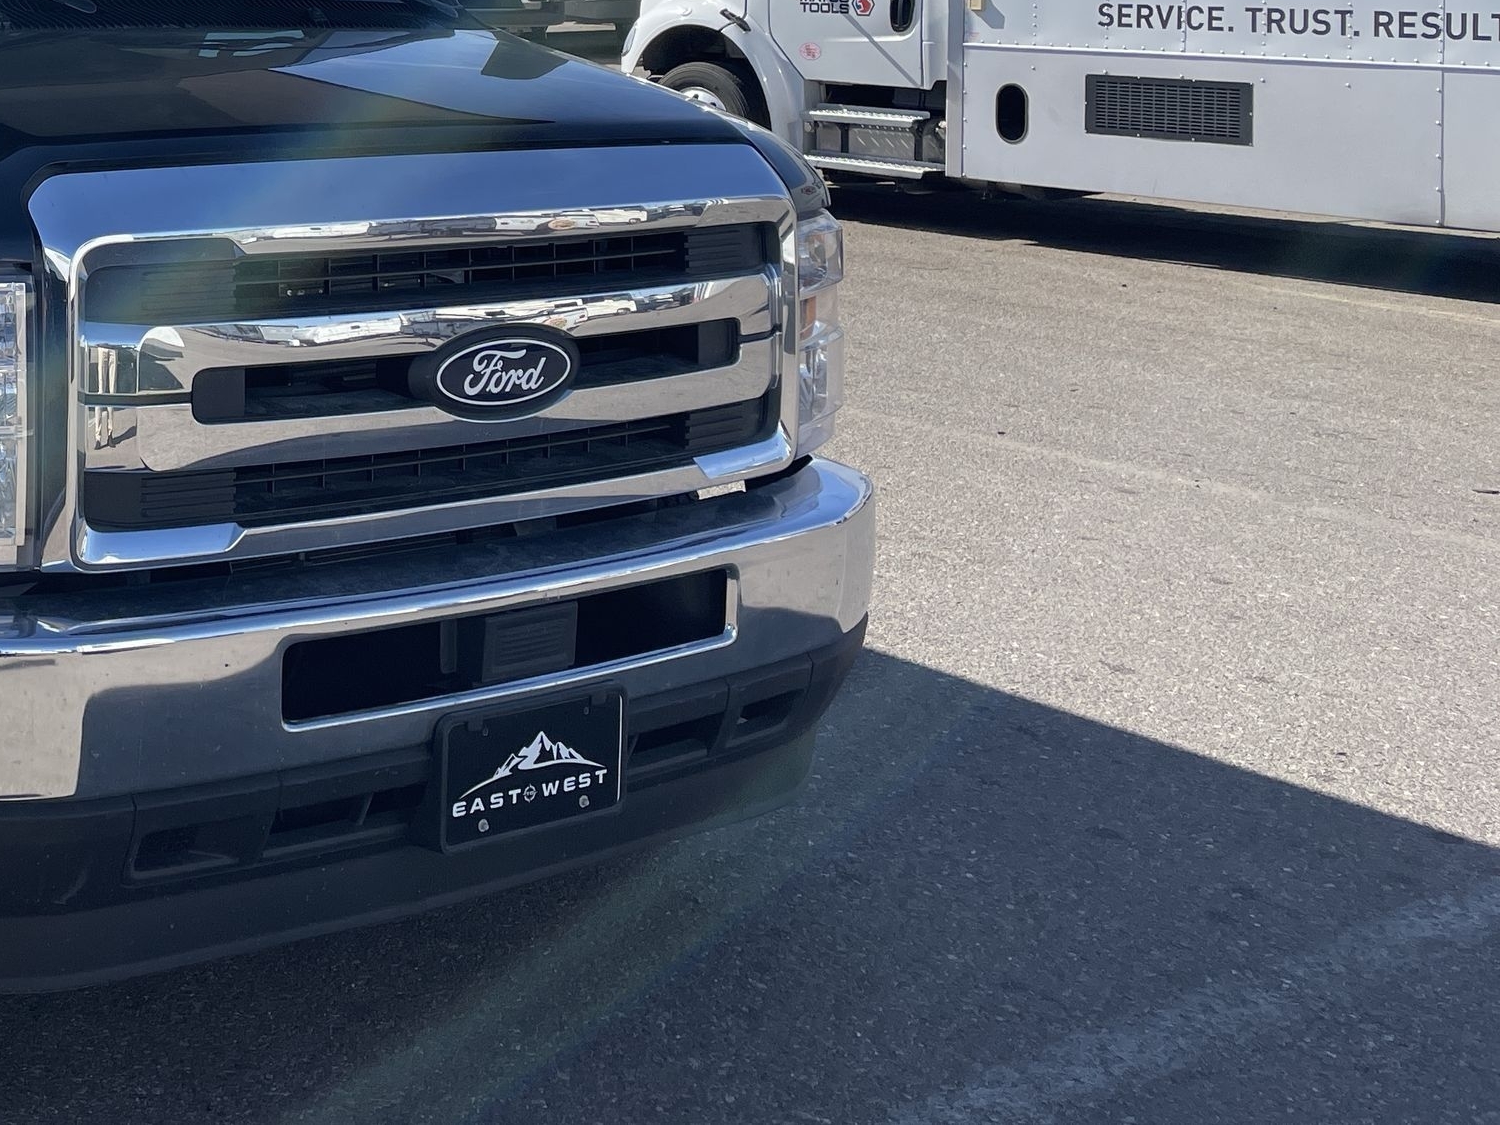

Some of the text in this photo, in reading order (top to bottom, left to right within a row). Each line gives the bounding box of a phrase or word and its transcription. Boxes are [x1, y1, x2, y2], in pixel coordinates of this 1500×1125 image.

[800, 2, 849, 14] TOOLS
[1097, 2, 1235, 32] SERVICE.
[1245, 6, 1360, 38] TRUST.
[464, 349, 546, 396] Ford
[452, 788, 521, 818] EAST
[542, 769, 608, 797] WEST
